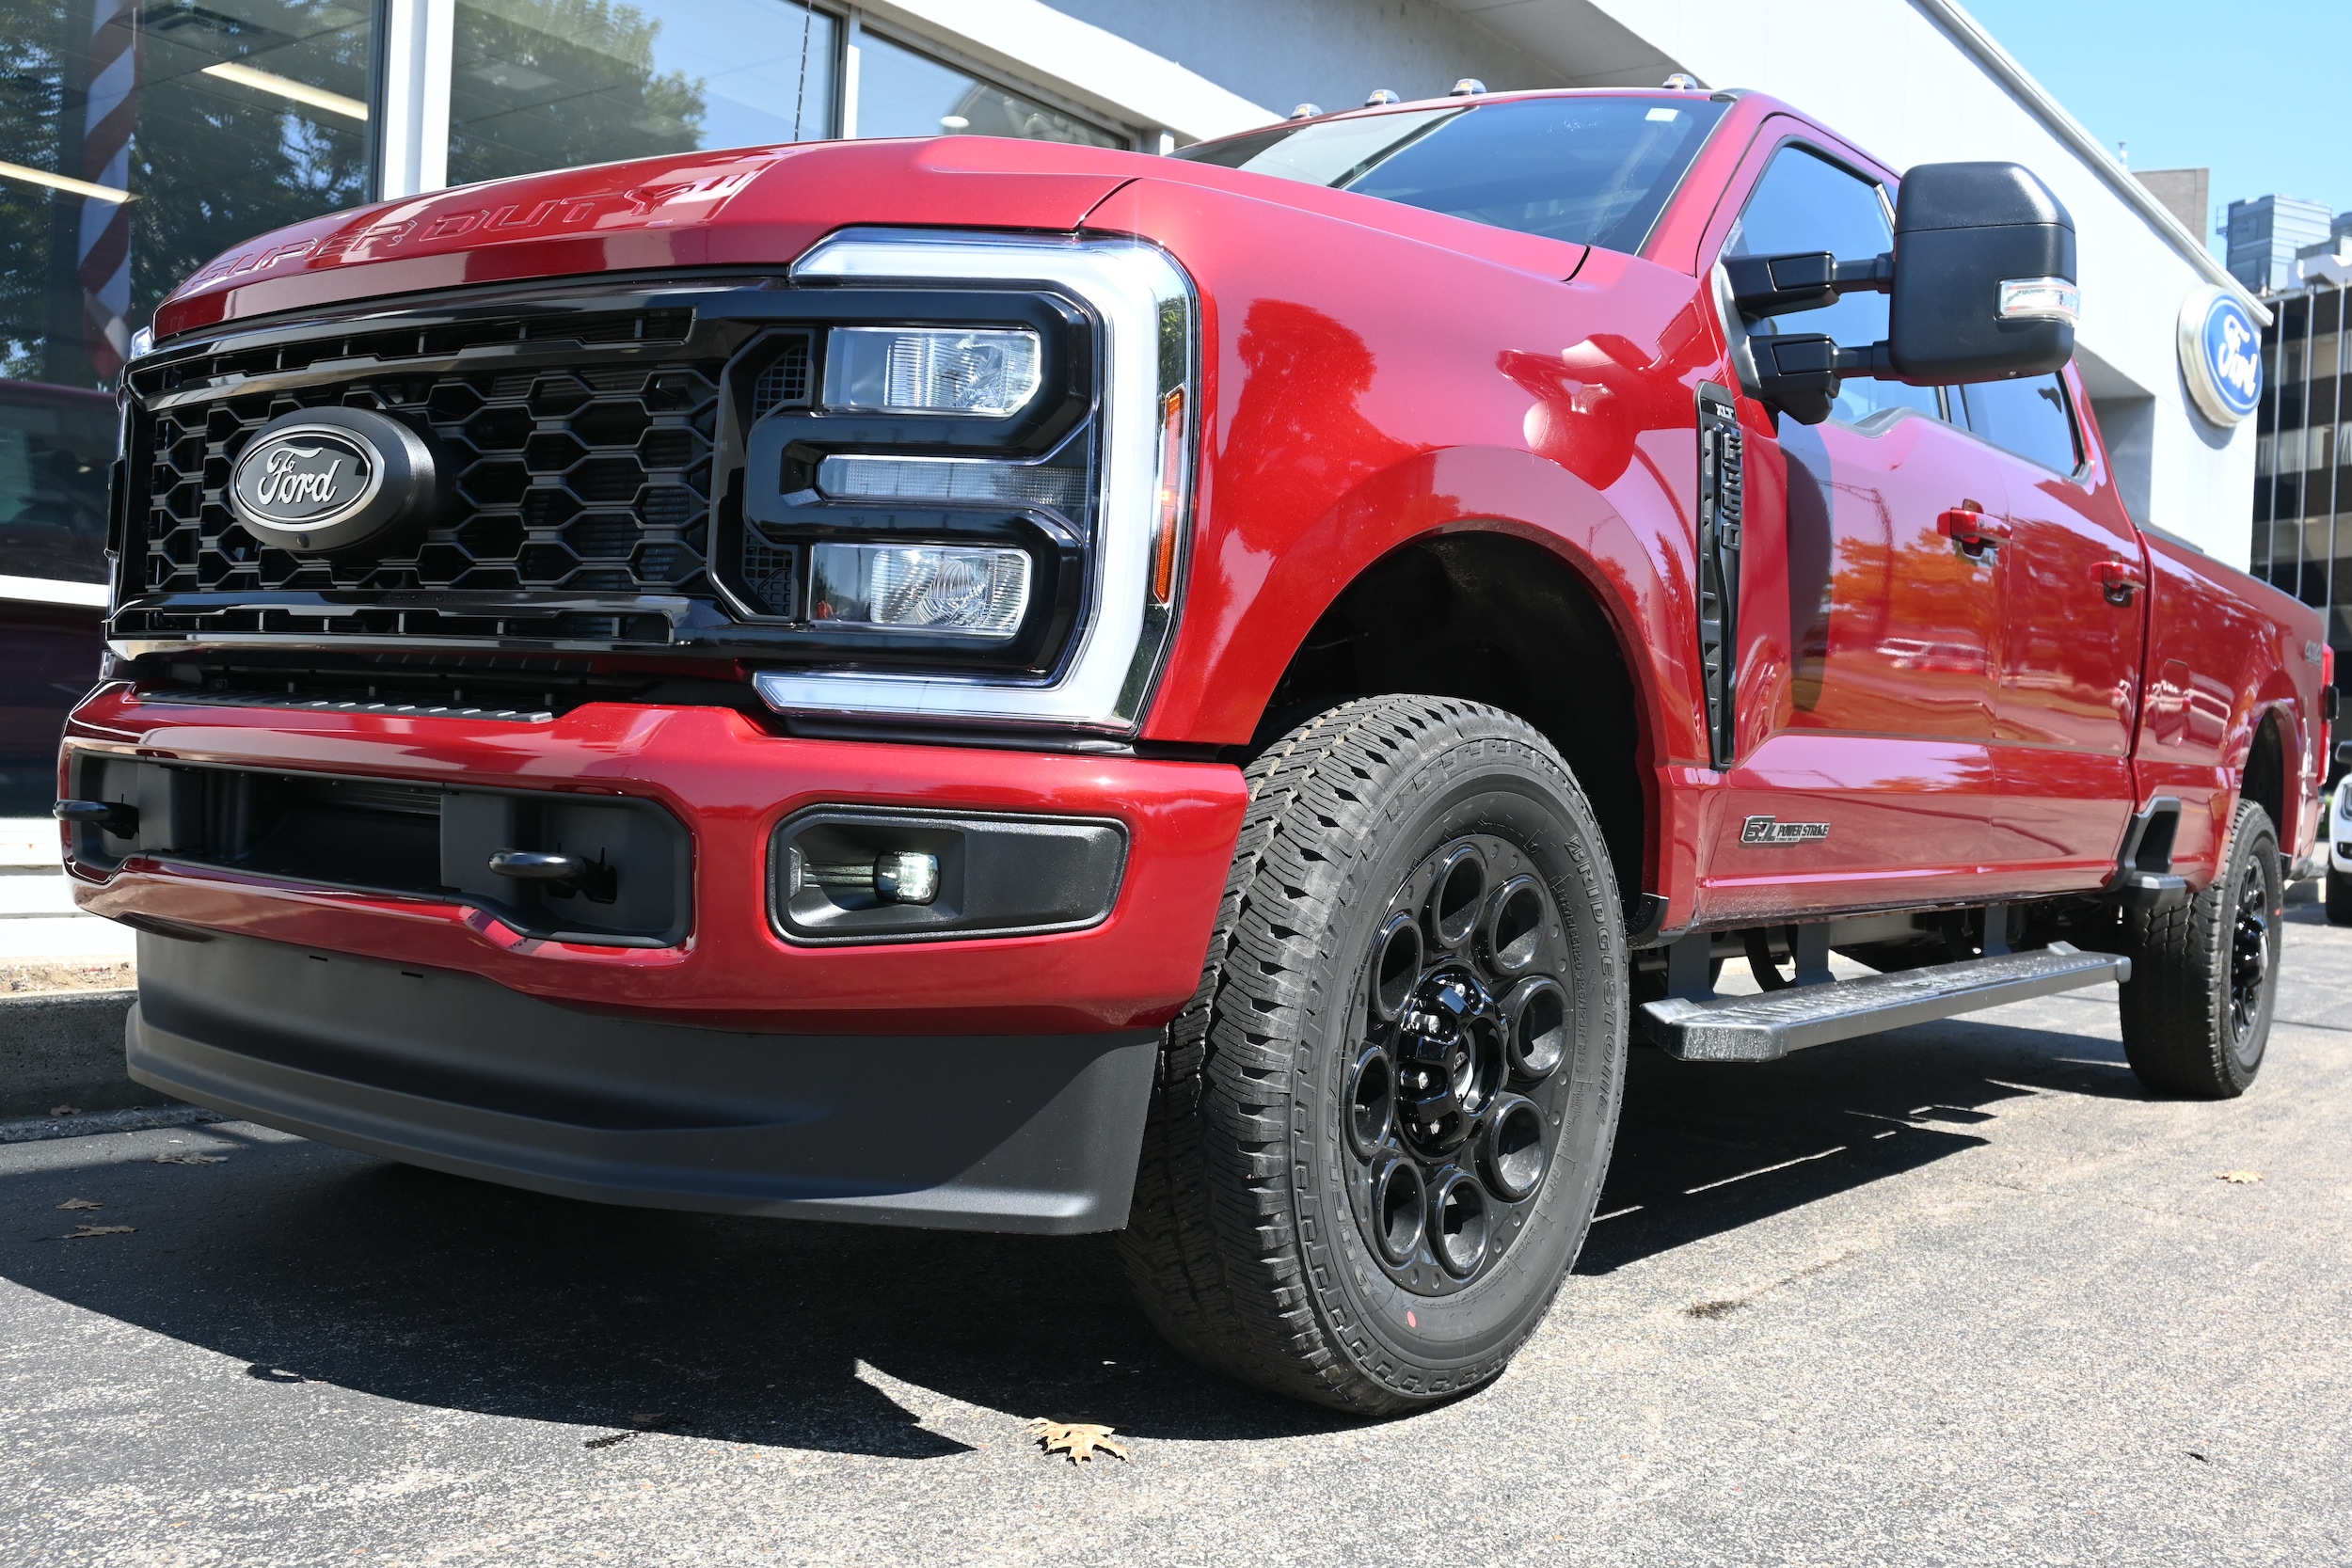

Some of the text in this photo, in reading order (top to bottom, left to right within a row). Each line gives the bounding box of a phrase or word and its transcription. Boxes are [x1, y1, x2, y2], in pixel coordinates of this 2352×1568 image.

[190, 182, 698, 287] SUPER DUTY
[2217, 314, 2258, 398] Ford
[1715, 403, 1735, 419] XLT
[257, 447, 342, 506] Ford
[1776, 824, 1803, 837] POWER
[1802, 824, 1829, 837] STROKE
[1565, 832, 1616, 1126] BRIDGESTONE
